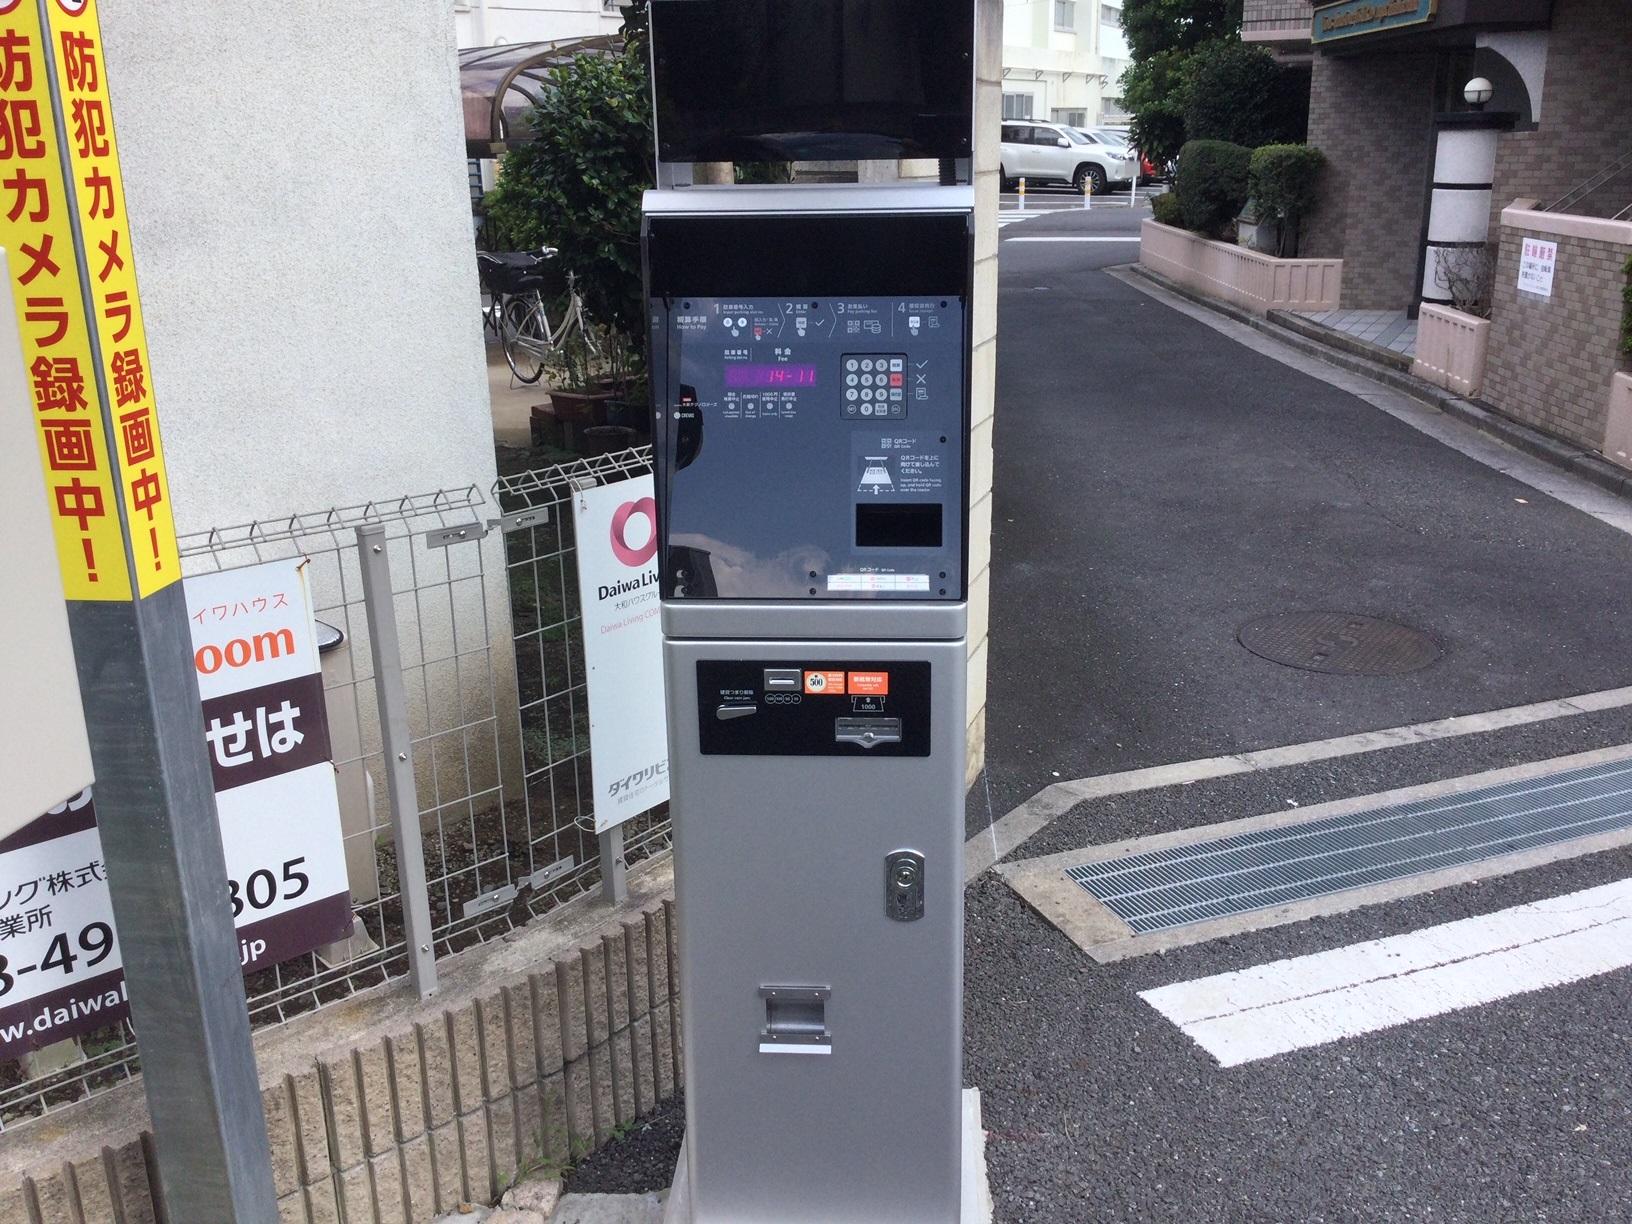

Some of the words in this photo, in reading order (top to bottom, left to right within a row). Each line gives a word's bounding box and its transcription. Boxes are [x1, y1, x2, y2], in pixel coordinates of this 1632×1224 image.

[786, 303, 793, 314] 2
[837, 303, 845, 314] 3
[898, 303, 906, 313] 4
[598, 578, 641, 601] Daiwa
[615, 591, 660, 610] 大和ハウスグル
[195, 628, 296, 675] oom
[608, 759, 669, 798] ダイワリビ
[0, 860, 108, 910] グ株式
